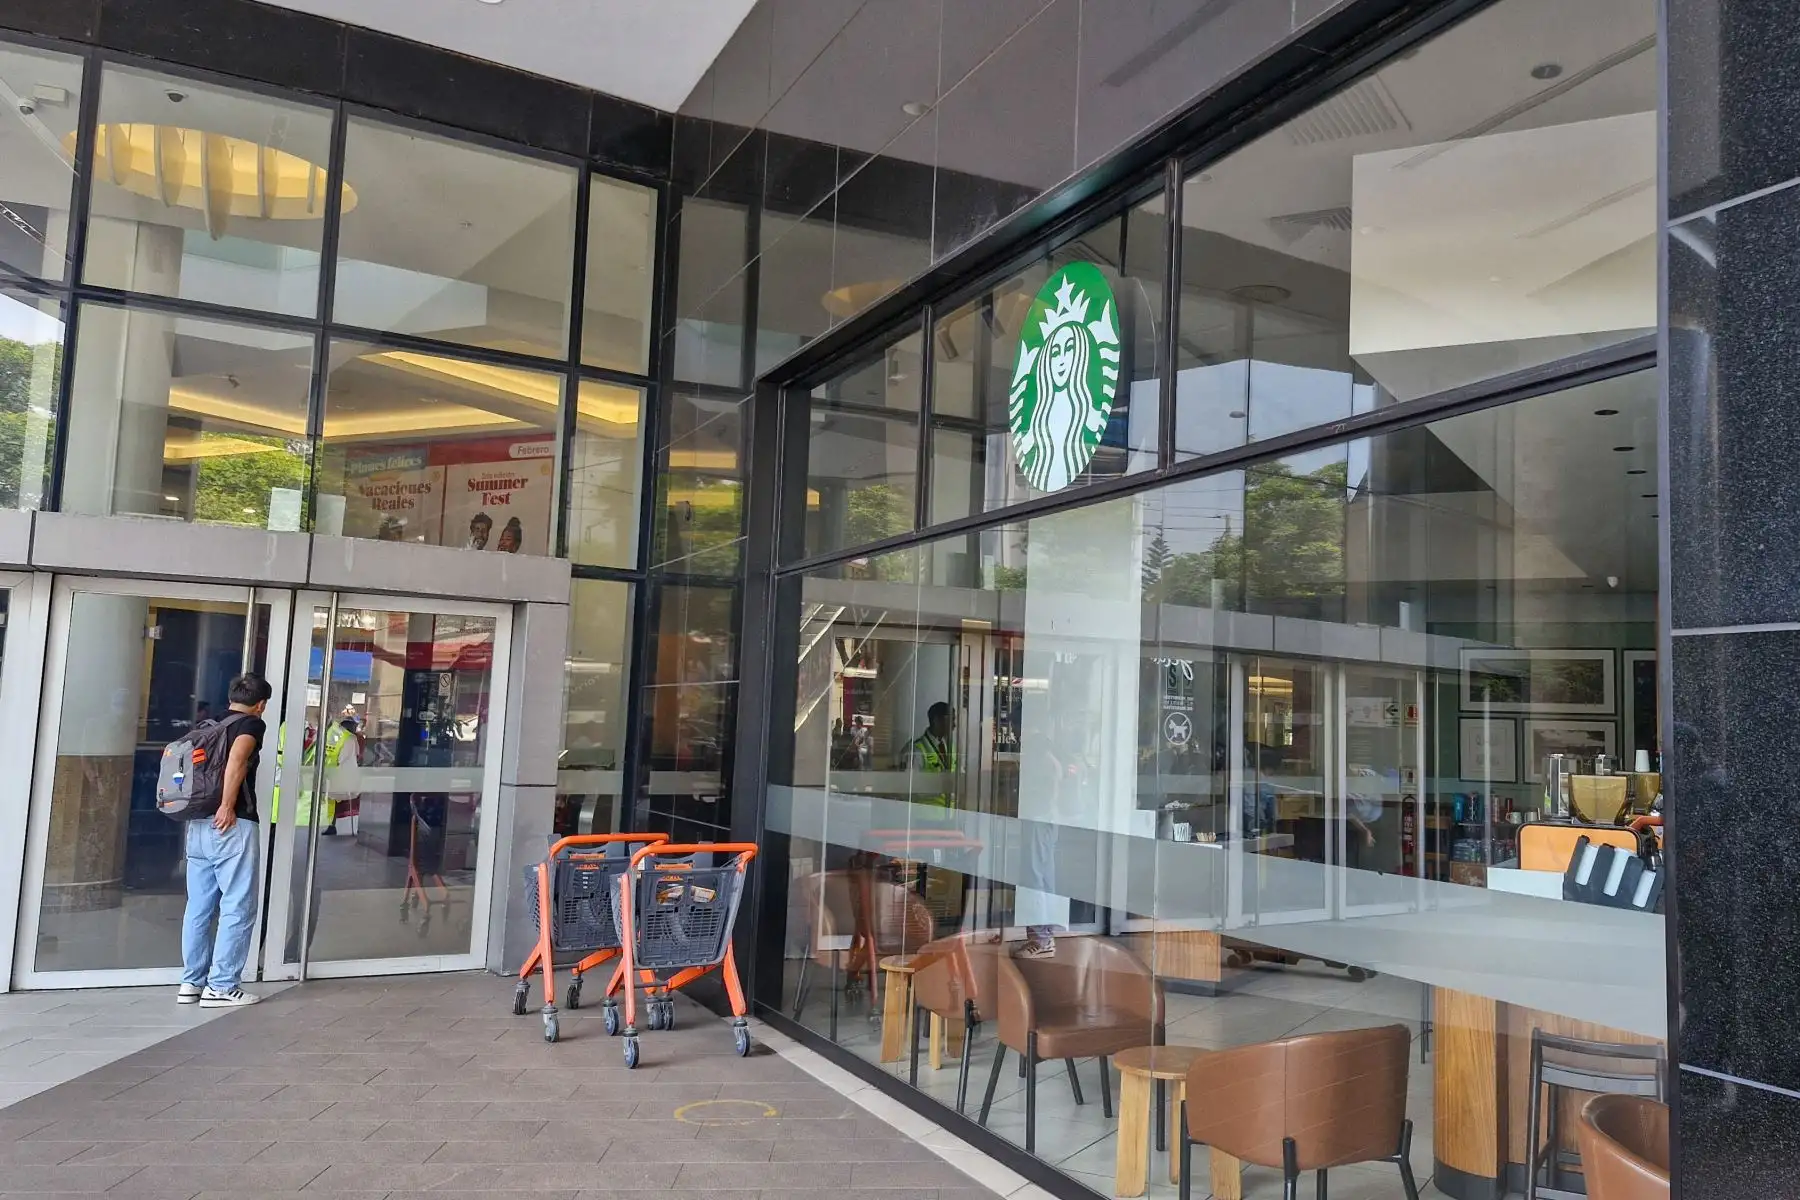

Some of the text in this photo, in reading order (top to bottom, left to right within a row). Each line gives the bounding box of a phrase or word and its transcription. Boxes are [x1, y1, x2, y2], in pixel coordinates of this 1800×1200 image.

[517, 446, 549, 456] Febrero
[358, 480, 432, 497] Vacaciones
[467, 478, 529, 492] Summer
[371, 495, 415, 511] Reales
[482, 492, 512, 506] Fest
